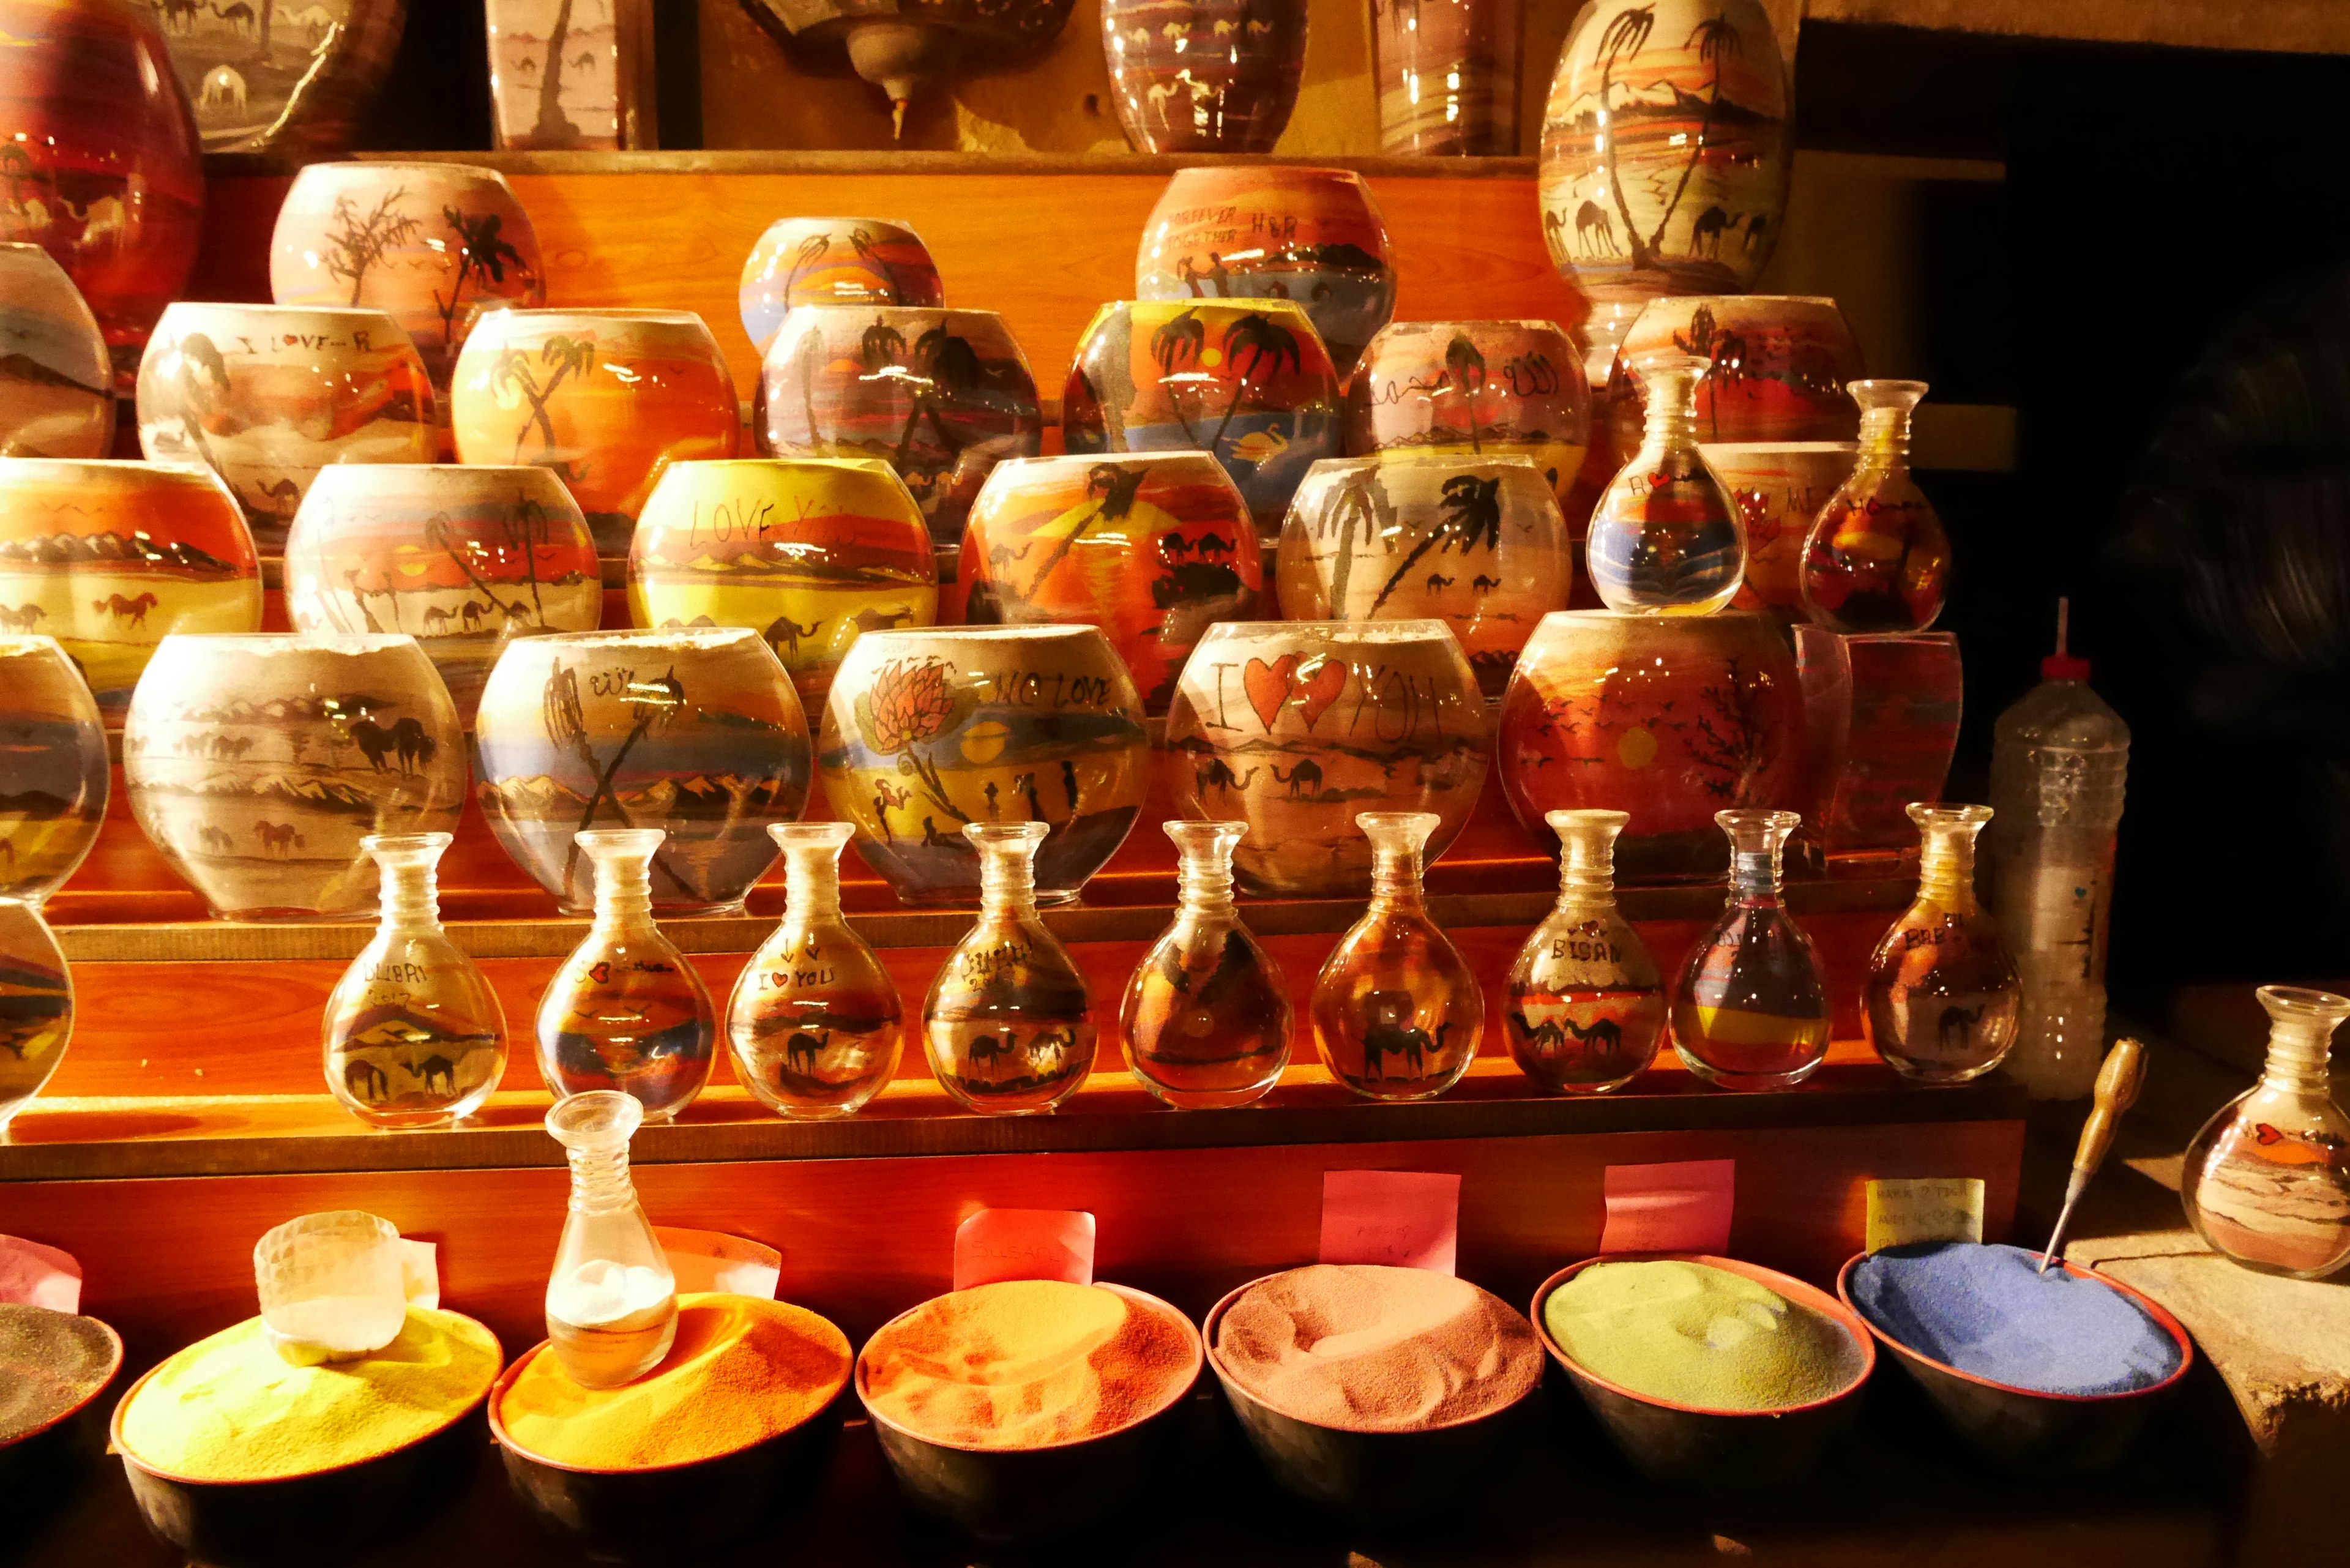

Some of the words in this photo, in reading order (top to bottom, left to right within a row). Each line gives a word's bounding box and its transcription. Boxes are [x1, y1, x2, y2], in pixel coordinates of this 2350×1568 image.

[690, 498, 775, 550] LOVE
[1053, 673, 1113, 708] LOVE
[1206, 663, 1244, 732] I
[1348, 663, 1443, 745] YOU
[1551, 938, 1622, 964] BISAN
[758, 973, 769, 991] I
[794, 968, 835, 988] YOU
